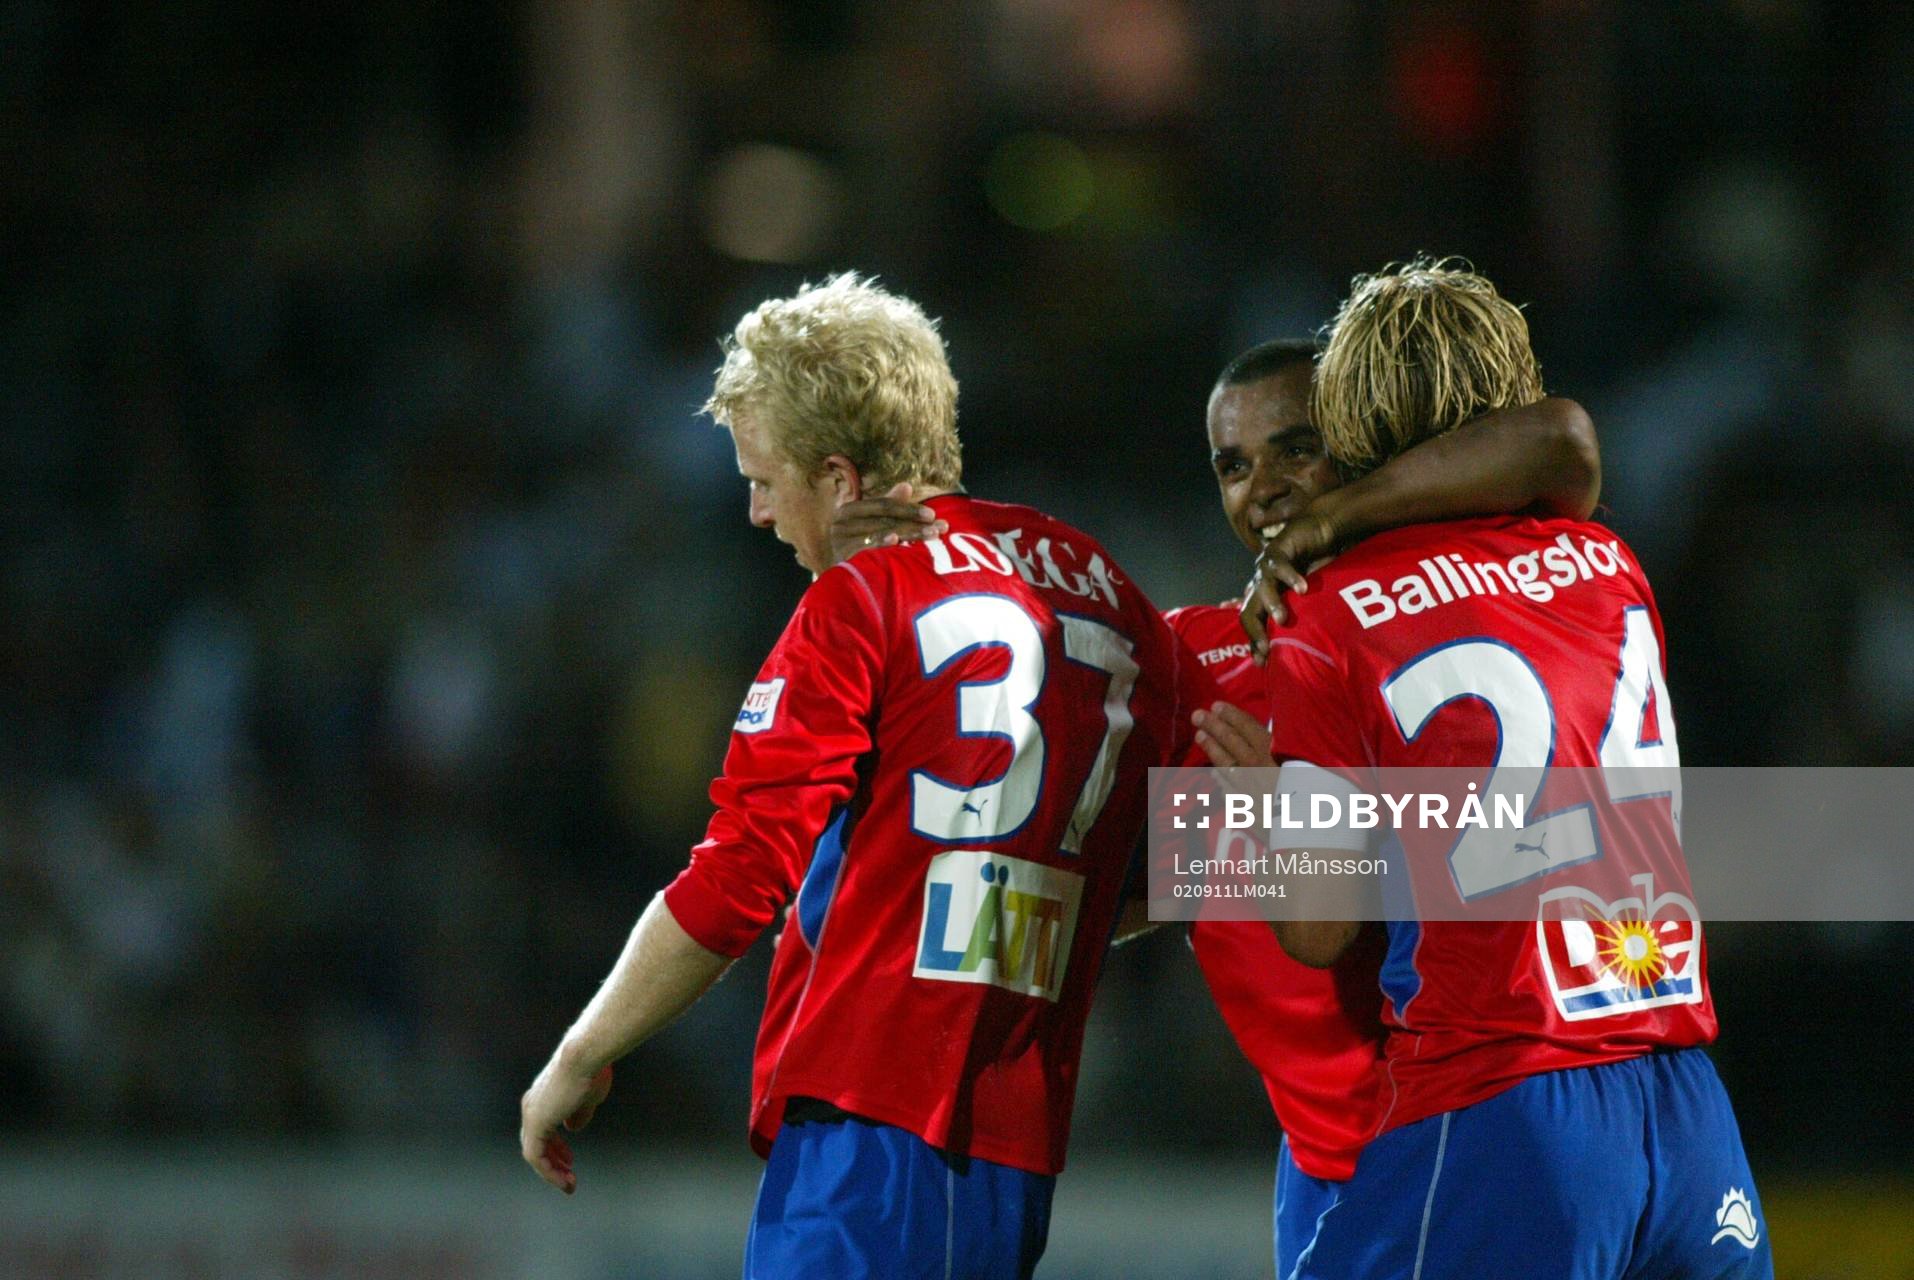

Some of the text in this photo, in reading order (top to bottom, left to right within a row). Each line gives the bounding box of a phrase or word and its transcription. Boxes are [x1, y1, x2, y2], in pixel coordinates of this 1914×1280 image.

[909, 592, 1139, 856] 37
[1379, 604, 1684, 902] 24
[918, 861, 1069, 992] LÄTT
